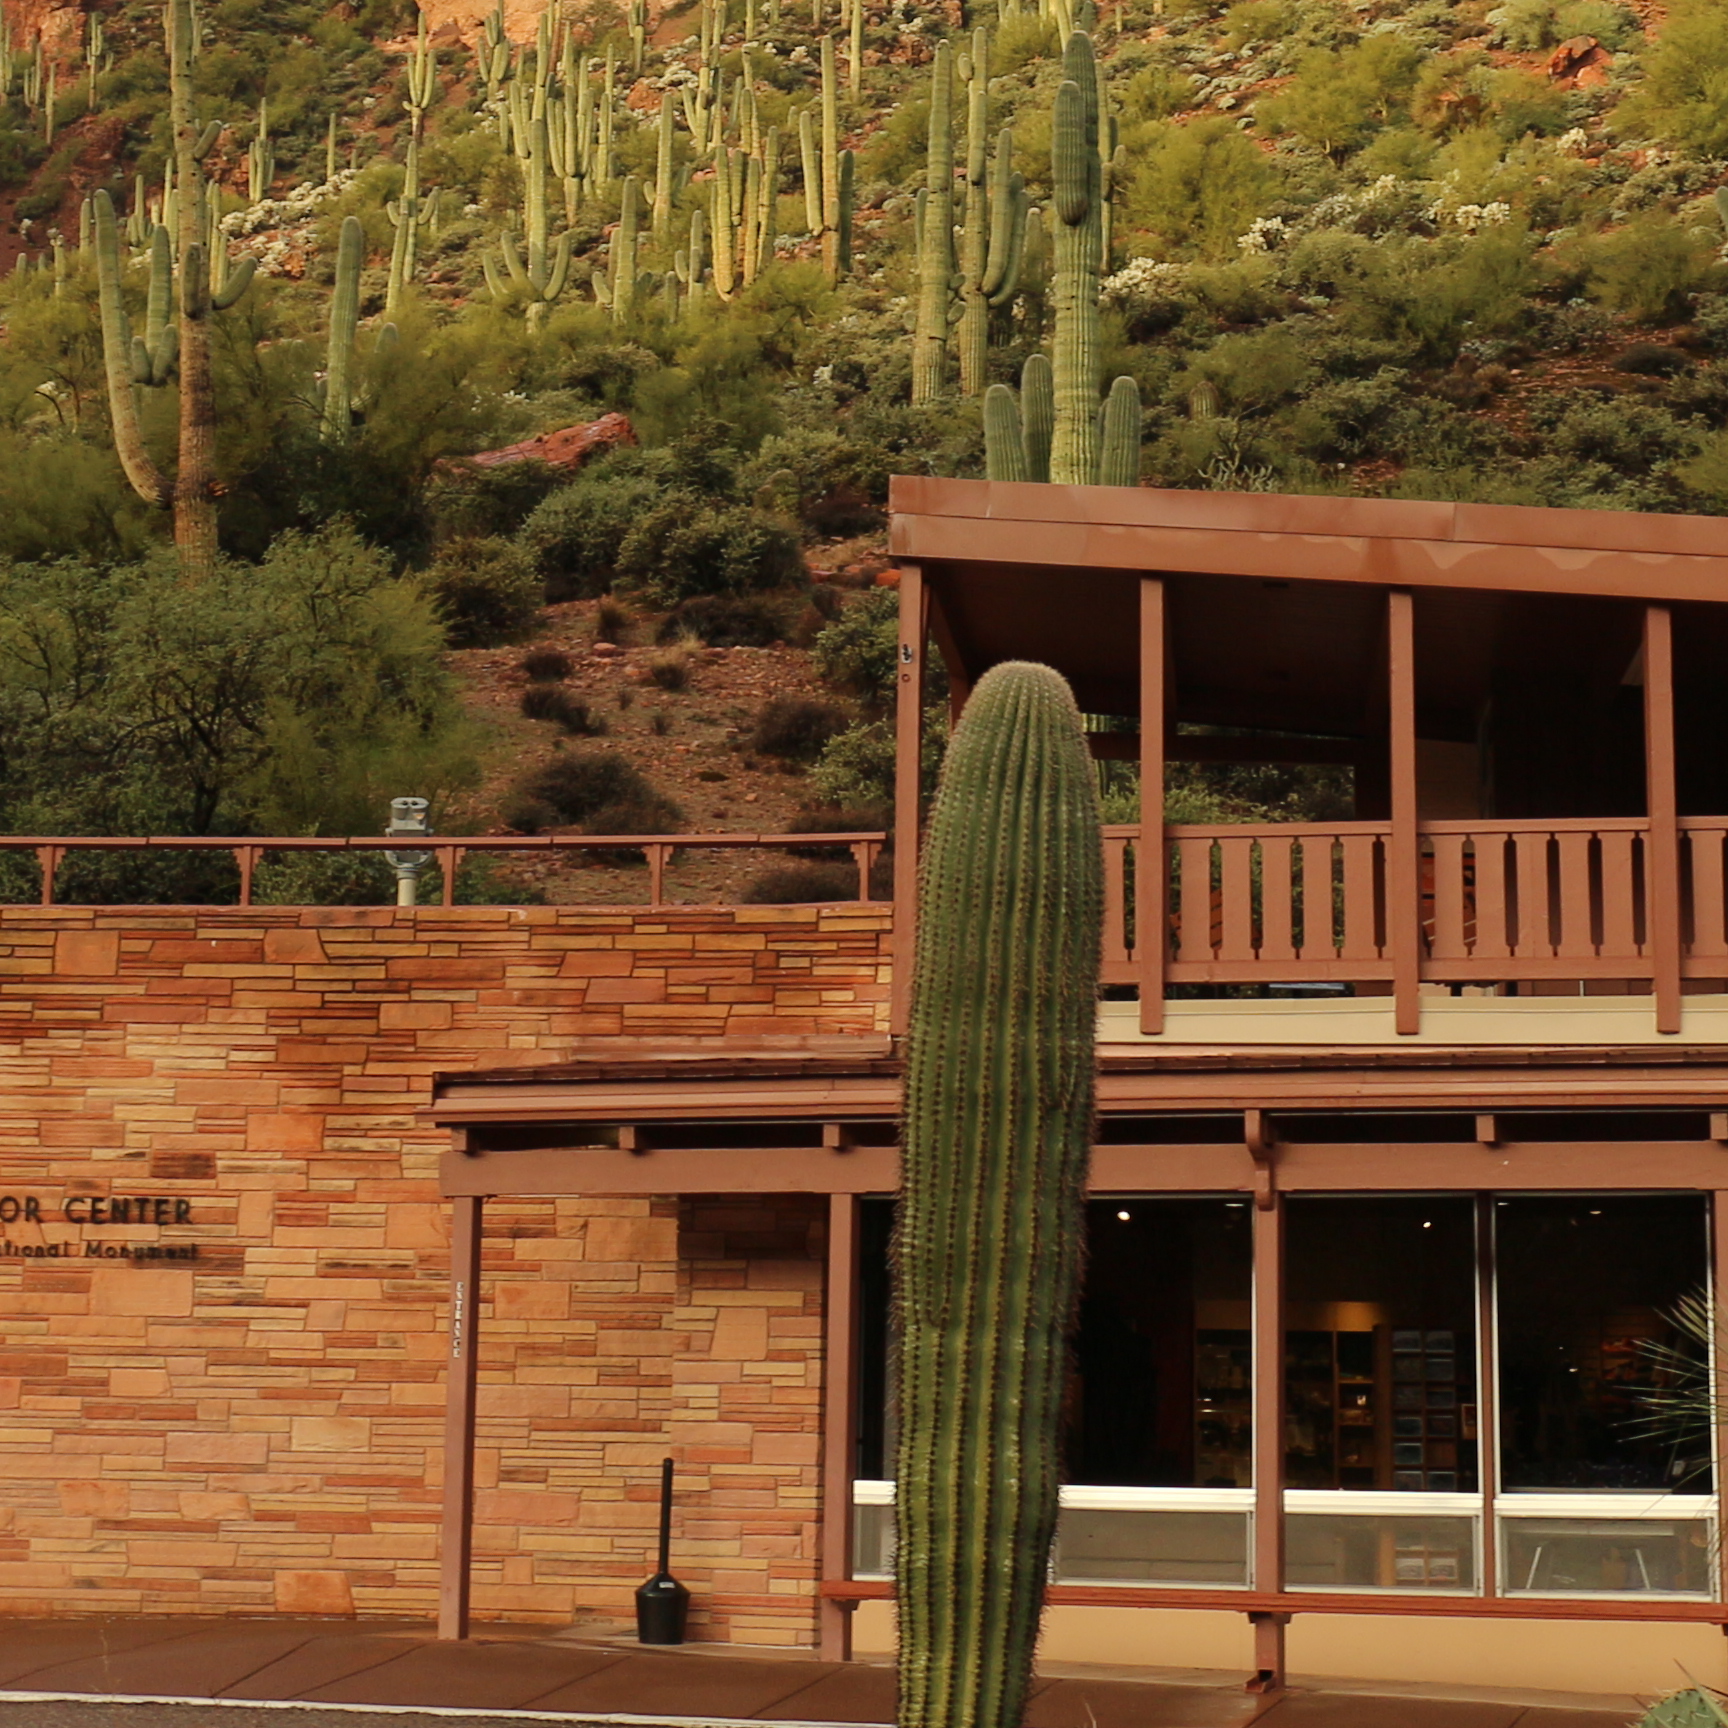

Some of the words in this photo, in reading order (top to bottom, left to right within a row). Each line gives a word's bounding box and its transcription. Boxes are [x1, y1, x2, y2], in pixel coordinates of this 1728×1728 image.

[65, 1197, 193, 1225] CENTER
[86, 1240, 198, 1260] Monument
[453, 1281, 464, 1359] ENTRANCE
